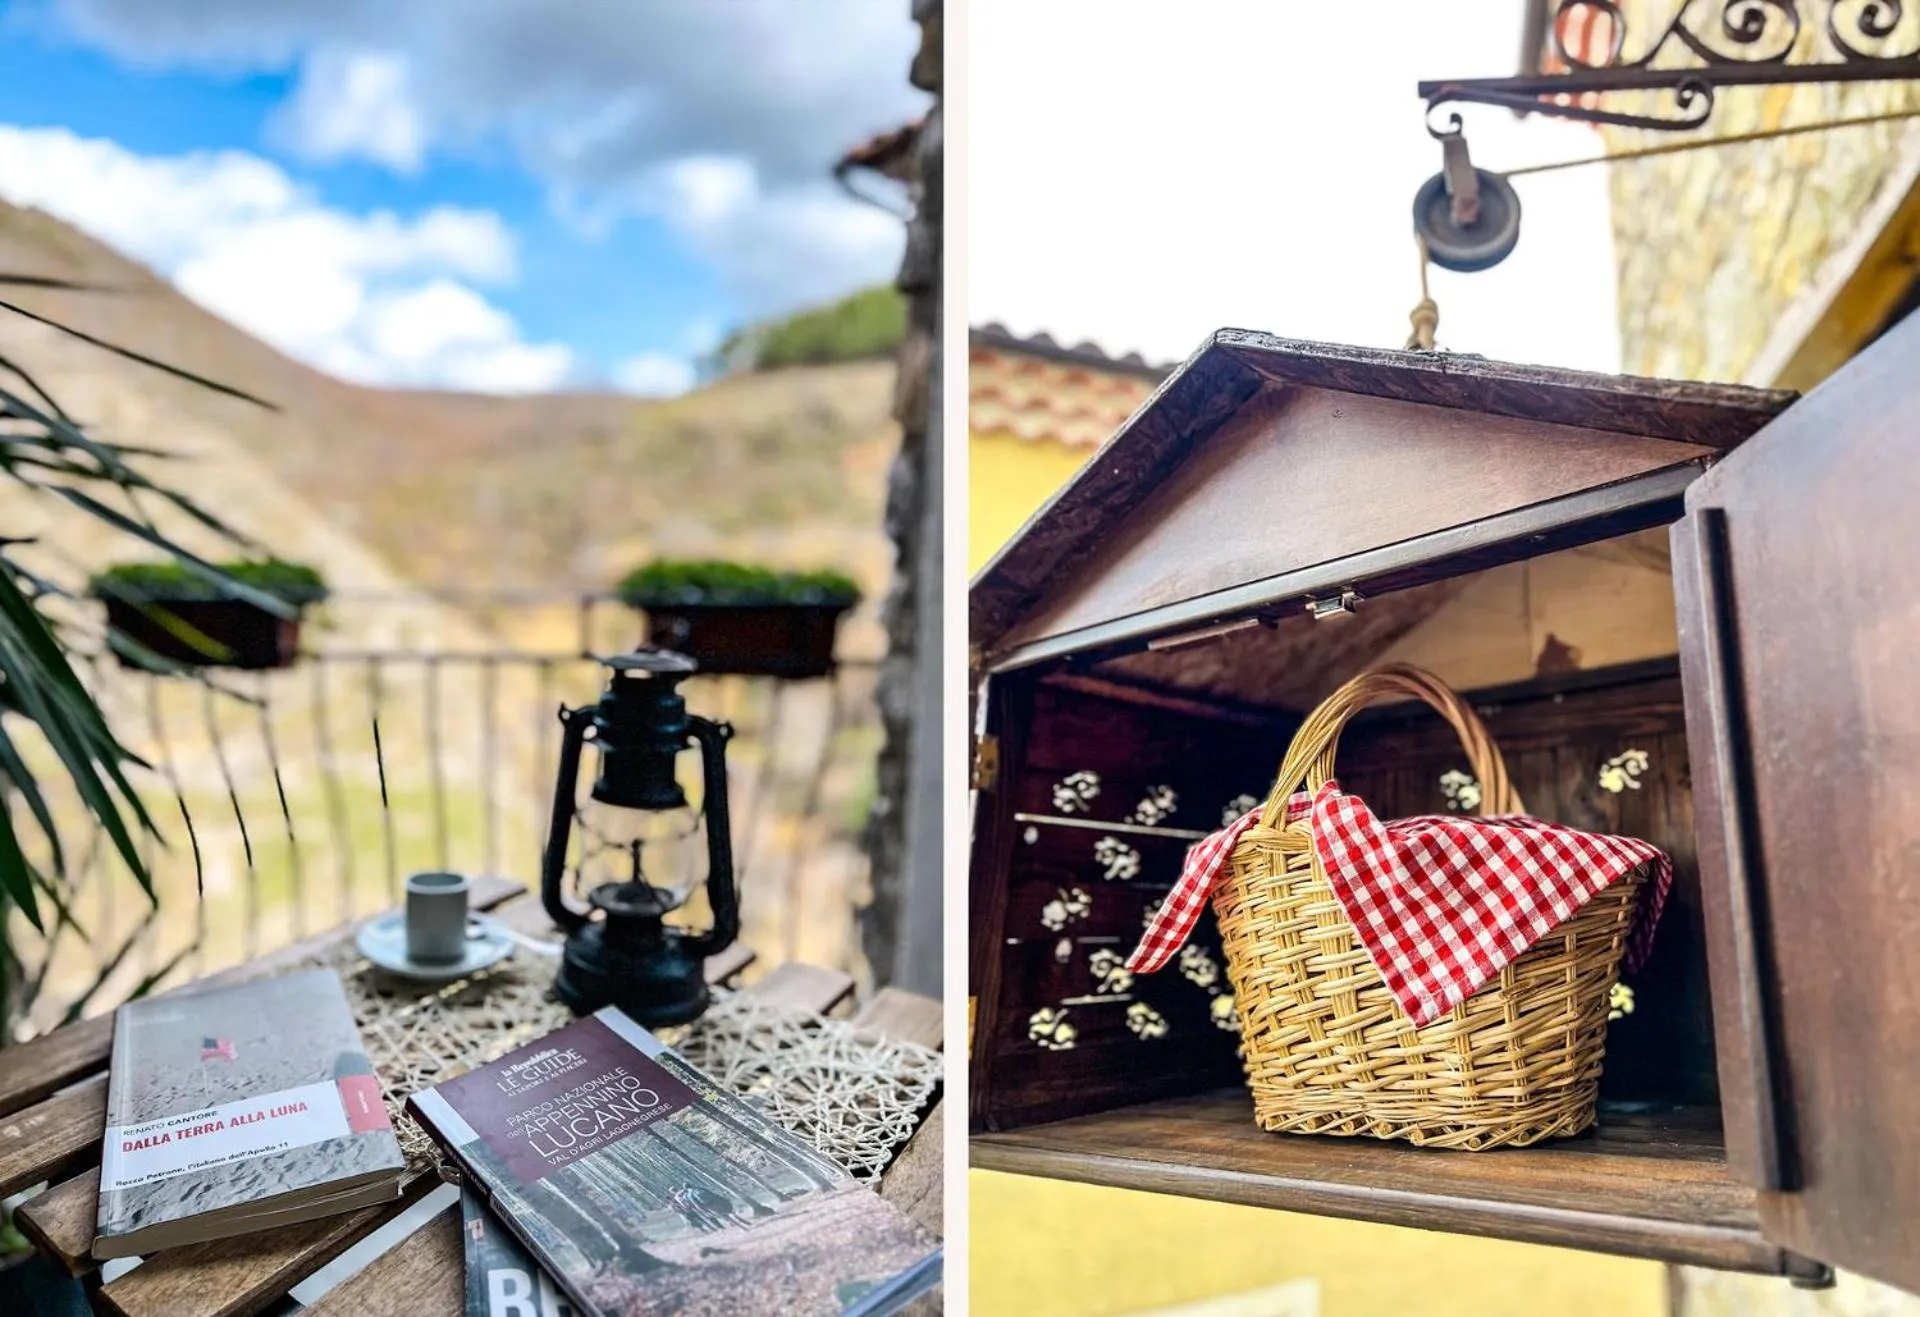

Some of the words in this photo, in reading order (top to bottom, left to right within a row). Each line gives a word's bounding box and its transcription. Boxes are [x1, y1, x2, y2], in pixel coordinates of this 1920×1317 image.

[496, 1076, 520, 1092] LE
[522, 1048, 582, 1081] GUIDE
[506, 1100, 553, 1127] PARCO
[552, 1066, 628, 1103] NAZIONALE
[122, 1132, 171, 1152] DALLA
[176, 1121, 224, 1141] TERRA
[230, 1111, 265, 1128] ALLA
[270, 1101, 308, 1118] LUNA
[123, 1122, 166, 1136] RENATO
[167, 1111, 218, 1126] CANTORE
[524, 1075, 641, 1137] APPENNINO
[529, 1088, 659, 1158] LUCANO
[548, 1153, 570, 1166] VAL
[571, 1138, 602, 1158] D'AGRI
[603, 1102, 672, 1142] LAGONEGRESE
[115, 1175, 144, 1186] Rocco
